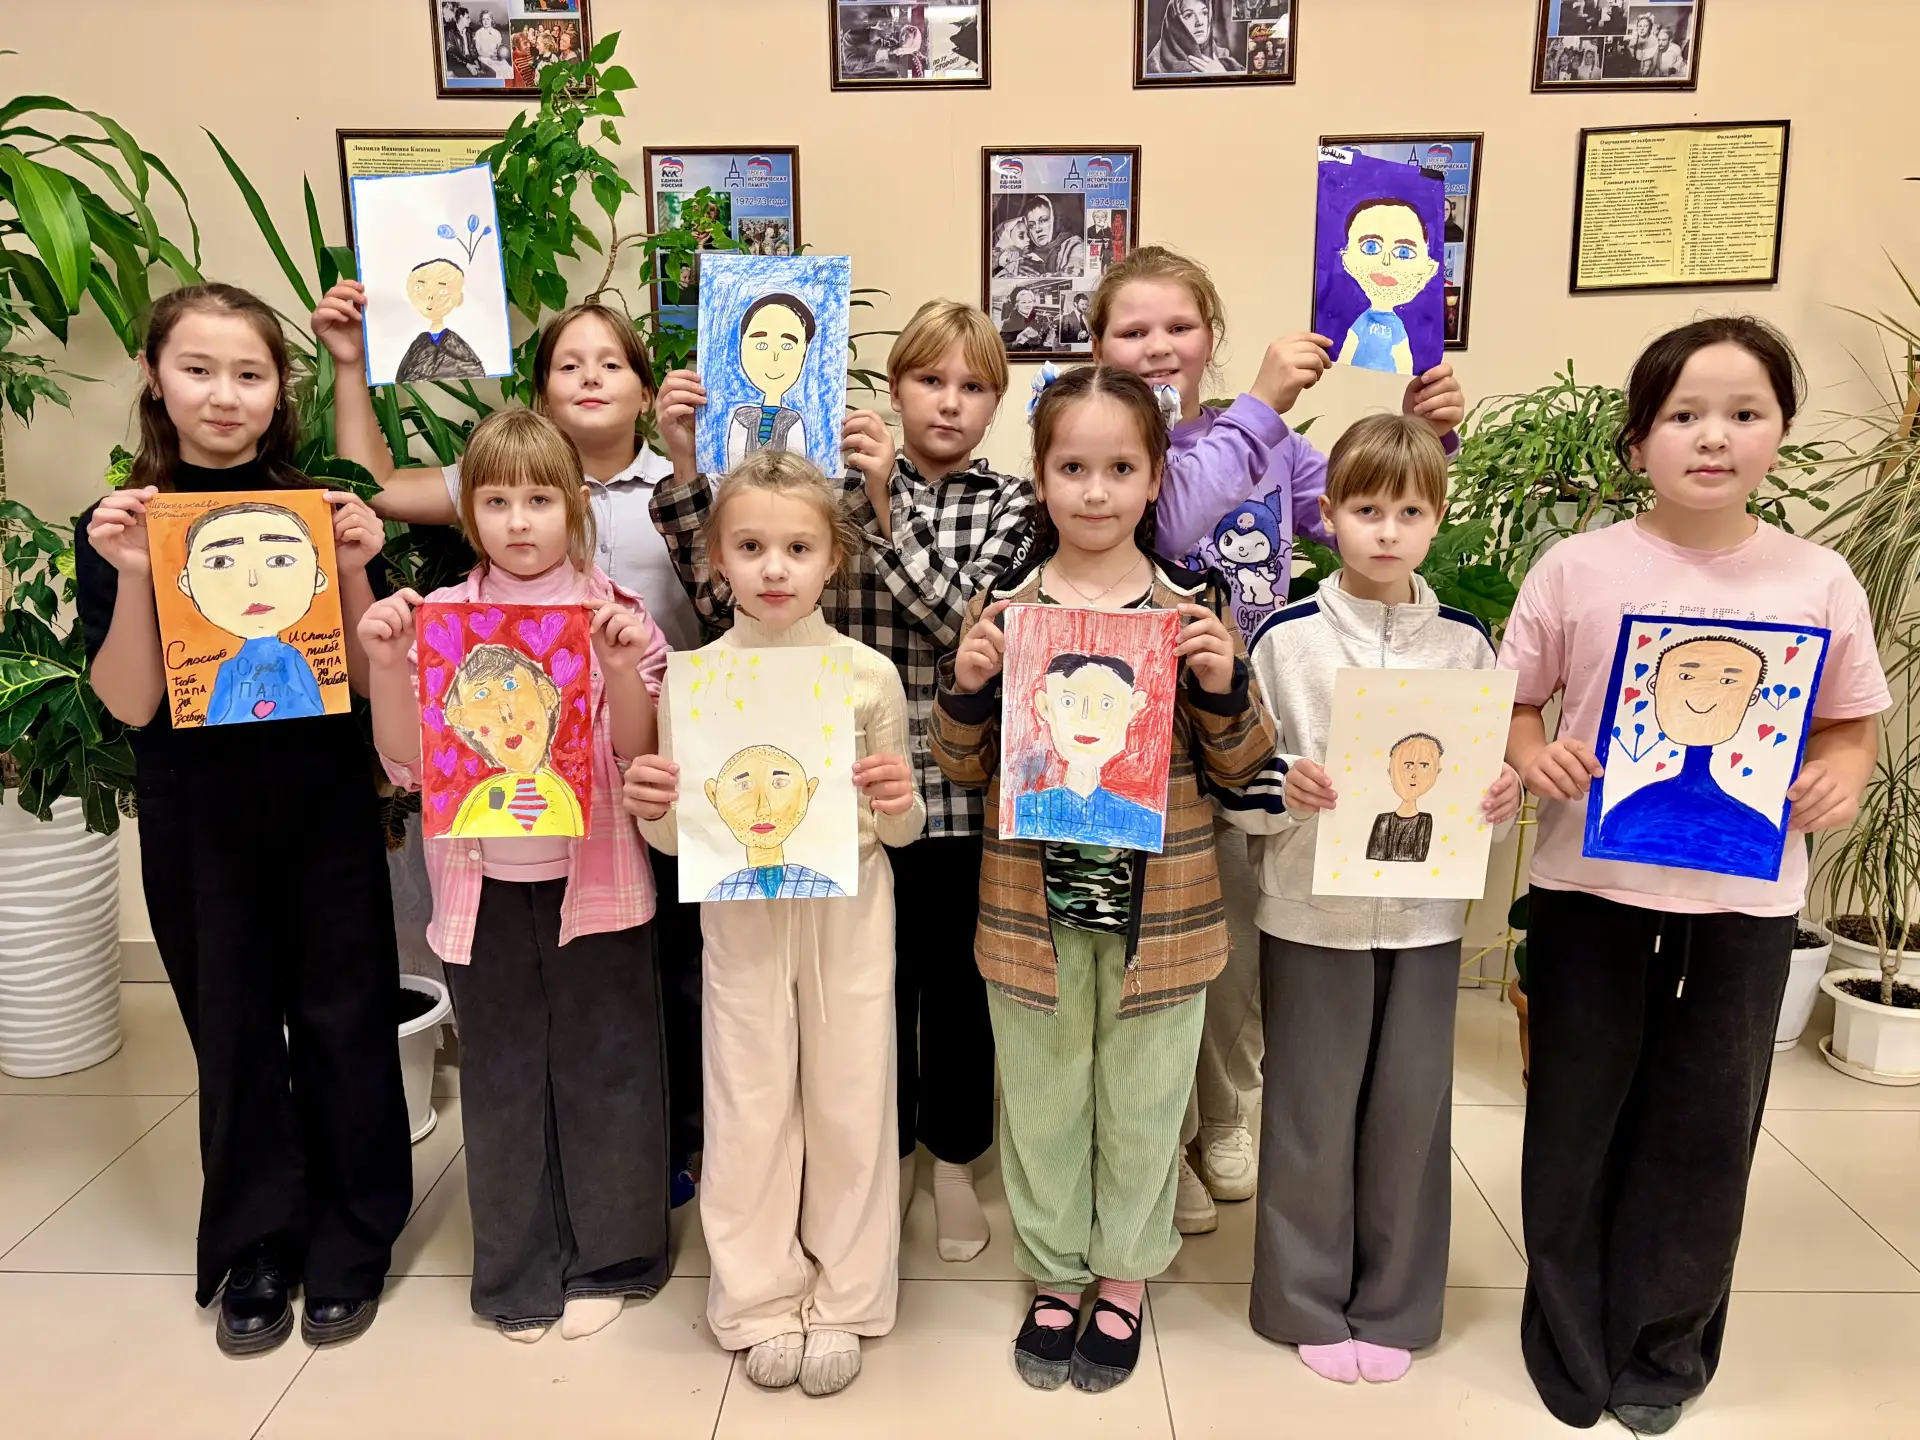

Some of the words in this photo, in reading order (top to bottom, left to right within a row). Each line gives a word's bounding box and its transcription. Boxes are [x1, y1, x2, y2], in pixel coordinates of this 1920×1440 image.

[735, 197, 767, 206] 1972-73
[769, 198, 787, 207] года
[1090, 198, 1110, 206] 1974
[1112, 200, 1126, 208] год
